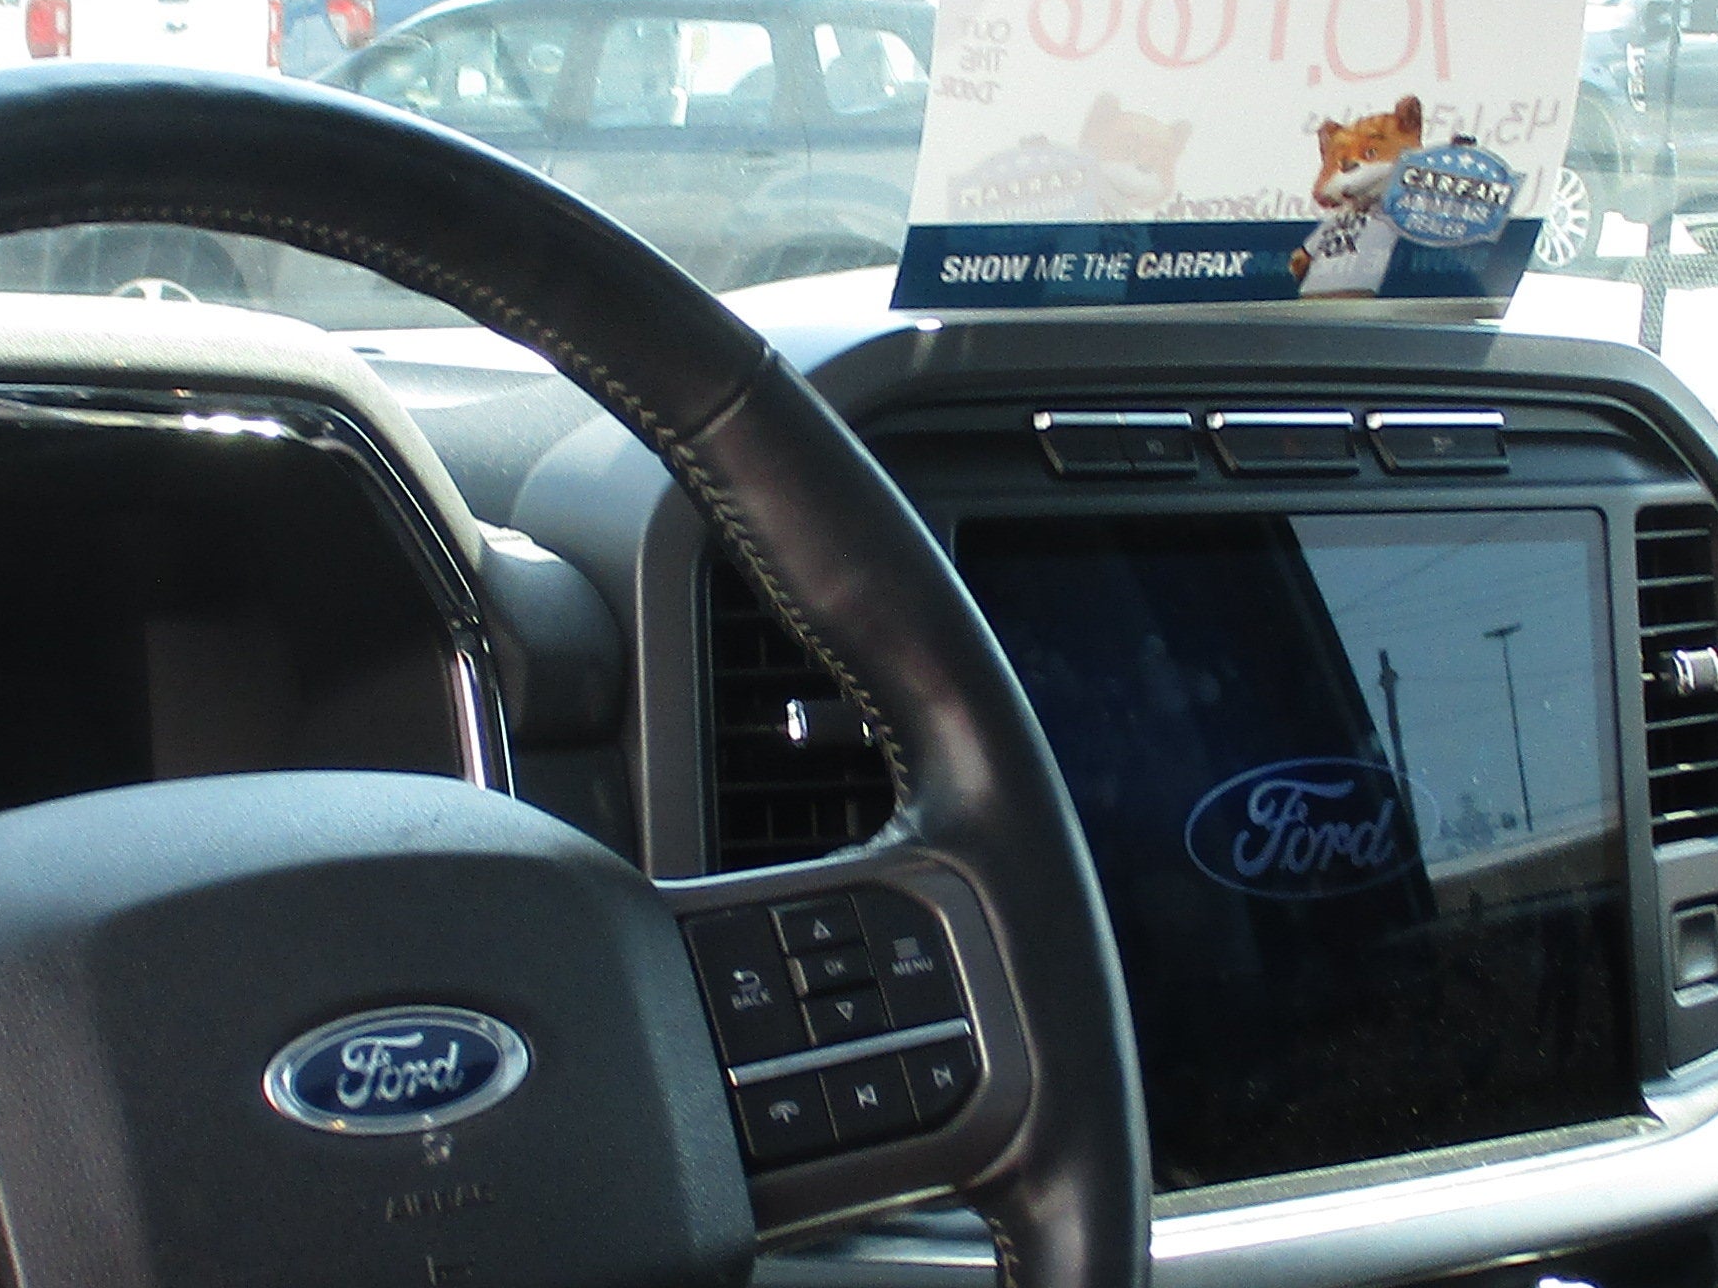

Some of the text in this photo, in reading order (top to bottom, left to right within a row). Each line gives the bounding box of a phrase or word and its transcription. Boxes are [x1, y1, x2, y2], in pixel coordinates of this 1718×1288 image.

[940, 249, 1253, 283] SHOW ME THE CARFAX
[1234, 779, 1396, 878] Ford
[891, 956, 933, 976] MENU
[336, 1031, 466, 1109] Ford
